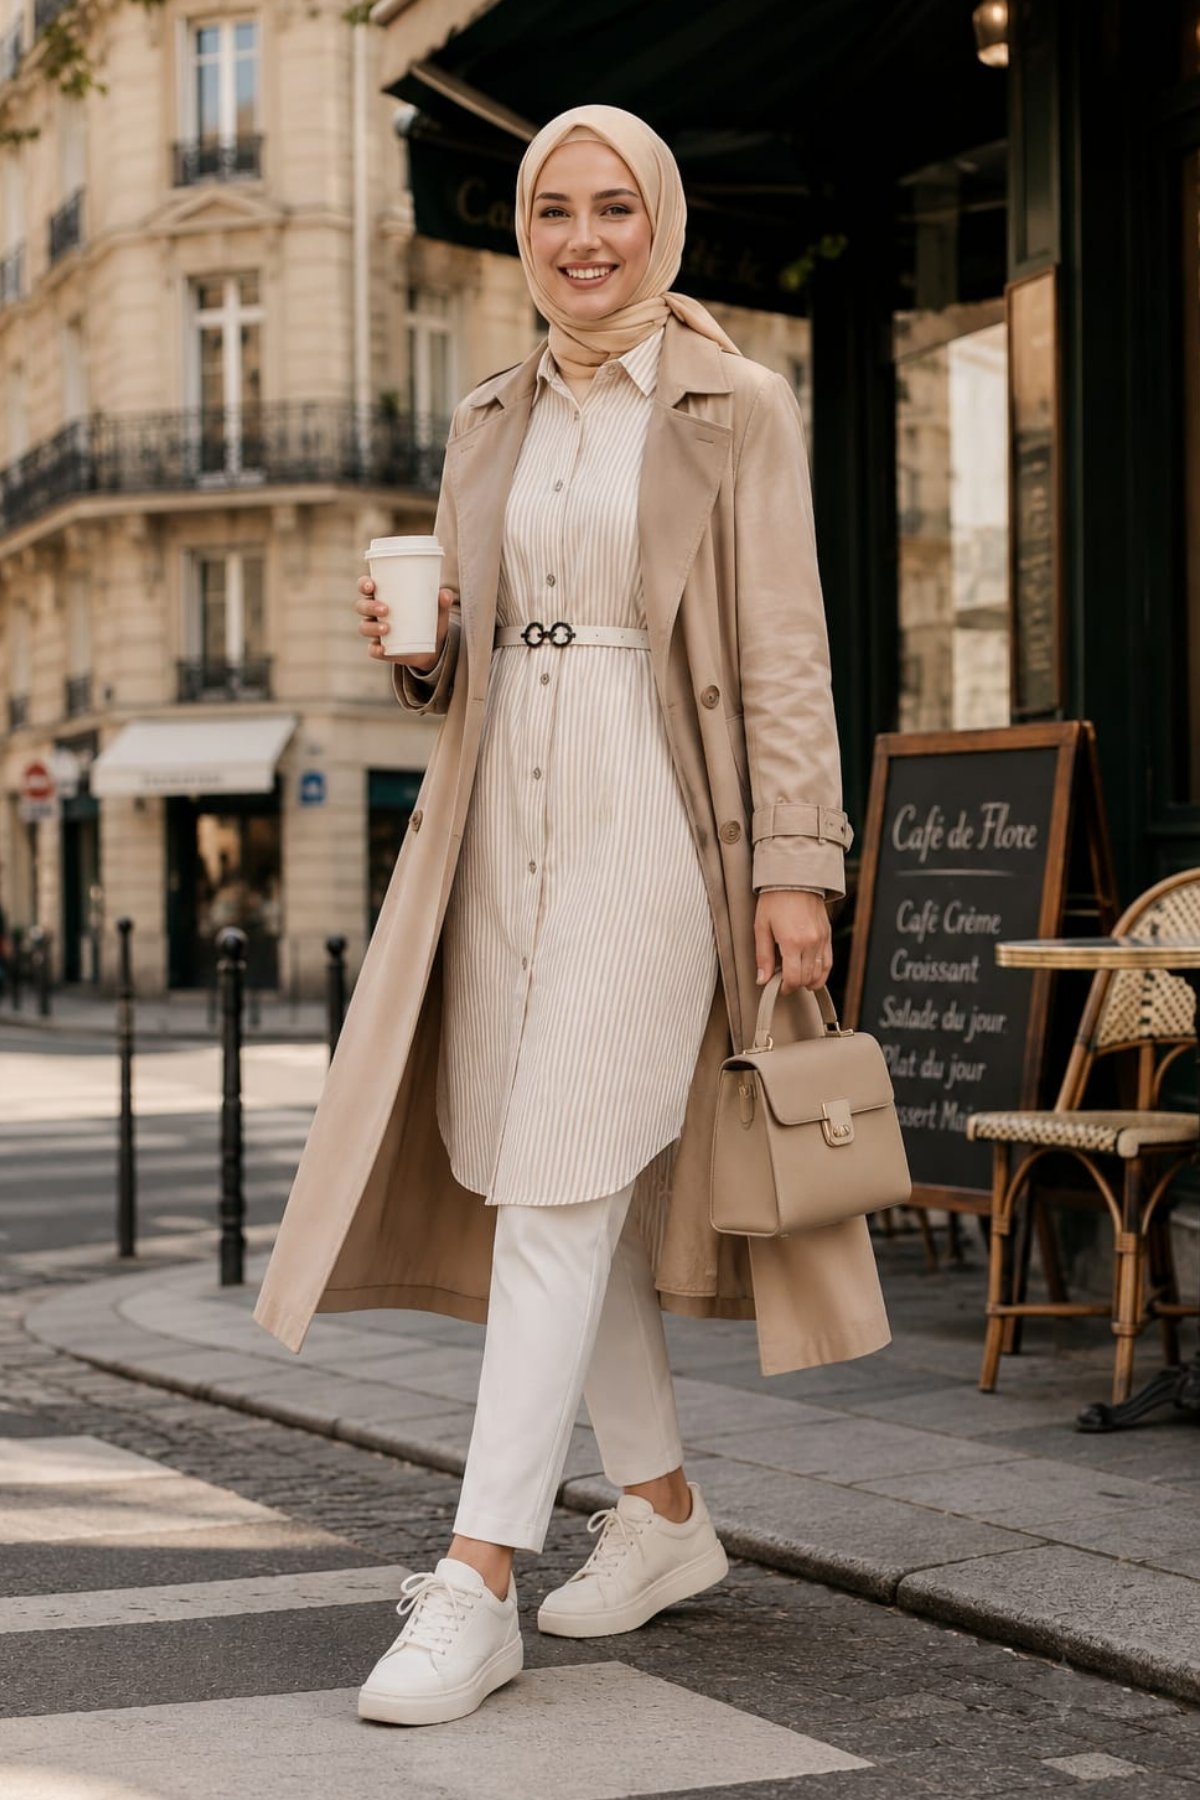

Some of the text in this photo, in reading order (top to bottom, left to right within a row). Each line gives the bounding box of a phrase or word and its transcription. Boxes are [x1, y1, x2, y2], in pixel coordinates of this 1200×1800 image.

[892, 802, 1038, 863] Café de Flore
[896, 900, 939, 944] Café
[890, 948, 979, 982] Croissant
[879, 995, 1006, 1043] Salade du jour
[882, 1044, 987, 1090] Plat du jour
[897, 1101, 937, 1130] ssert
